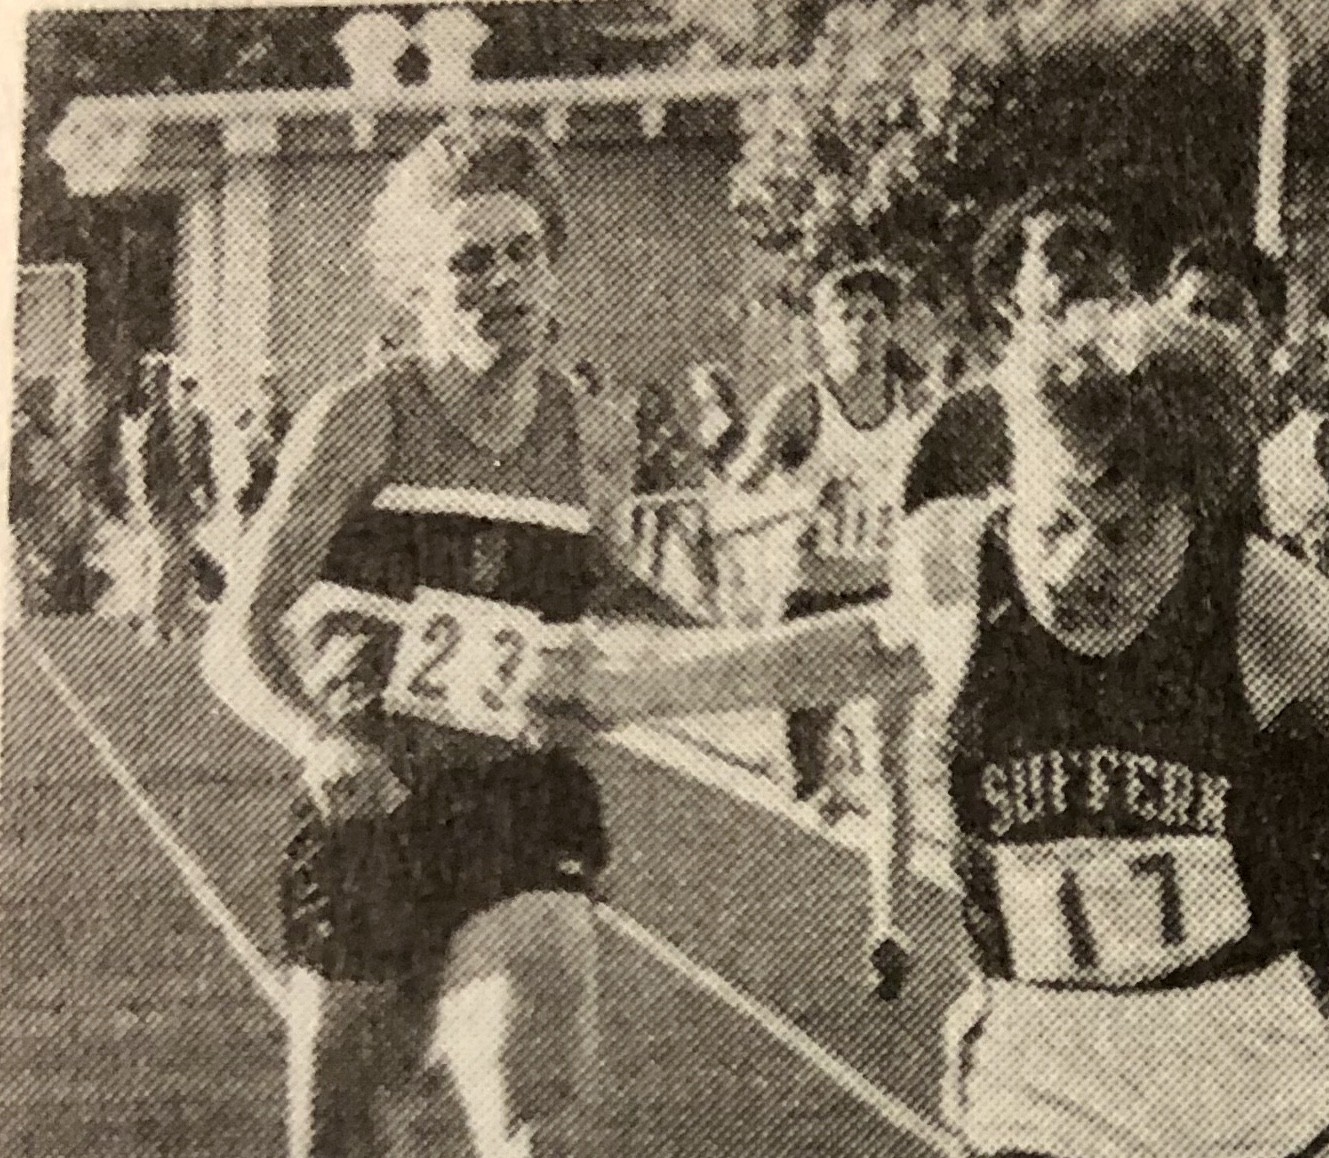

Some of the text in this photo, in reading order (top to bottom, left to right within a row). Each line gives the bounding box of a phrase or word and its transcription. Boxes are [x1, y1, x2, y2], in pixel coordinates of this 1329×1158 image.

[406, 612, 526, 712] 23
[981, 746, 1232, 838] SUFFERN
[1056, 851, 1187, 970] 17
